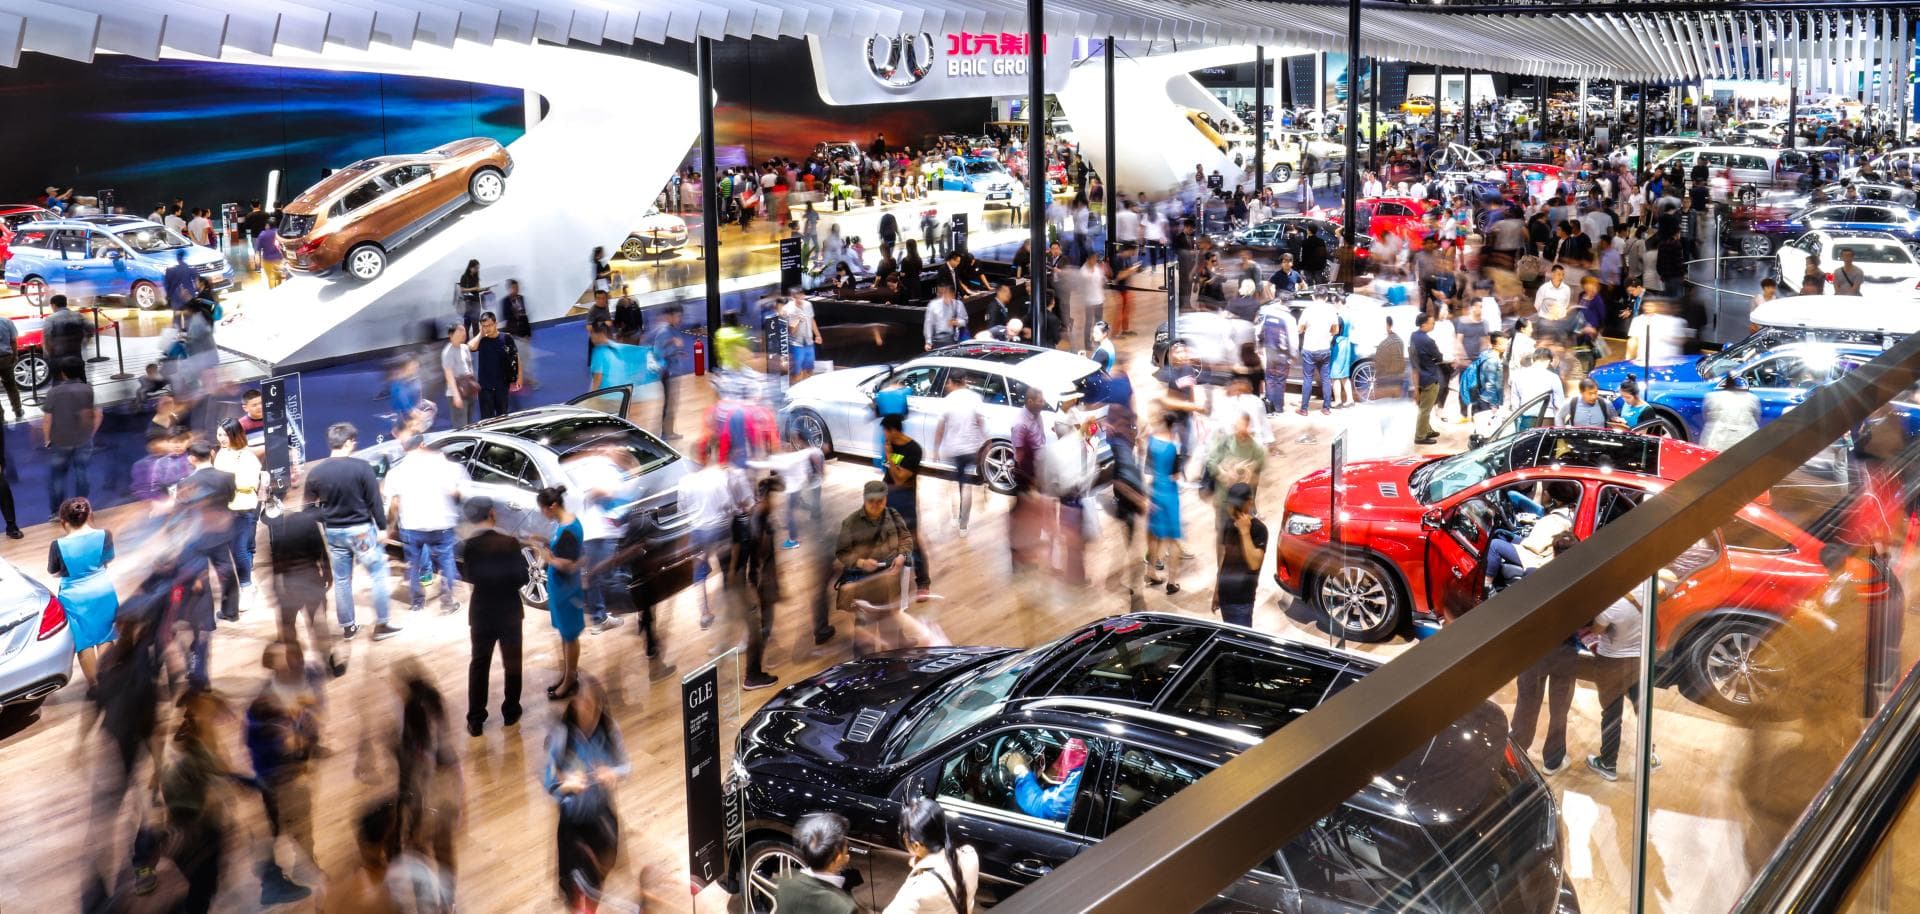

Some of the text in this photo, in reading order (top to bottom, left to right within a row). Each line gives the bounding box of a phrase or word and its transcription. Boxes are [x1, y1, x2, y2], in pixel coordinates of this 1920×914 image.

[948, 59, 1047, 76] BAIC GRO
[689, 680, 713, 709] GLE
